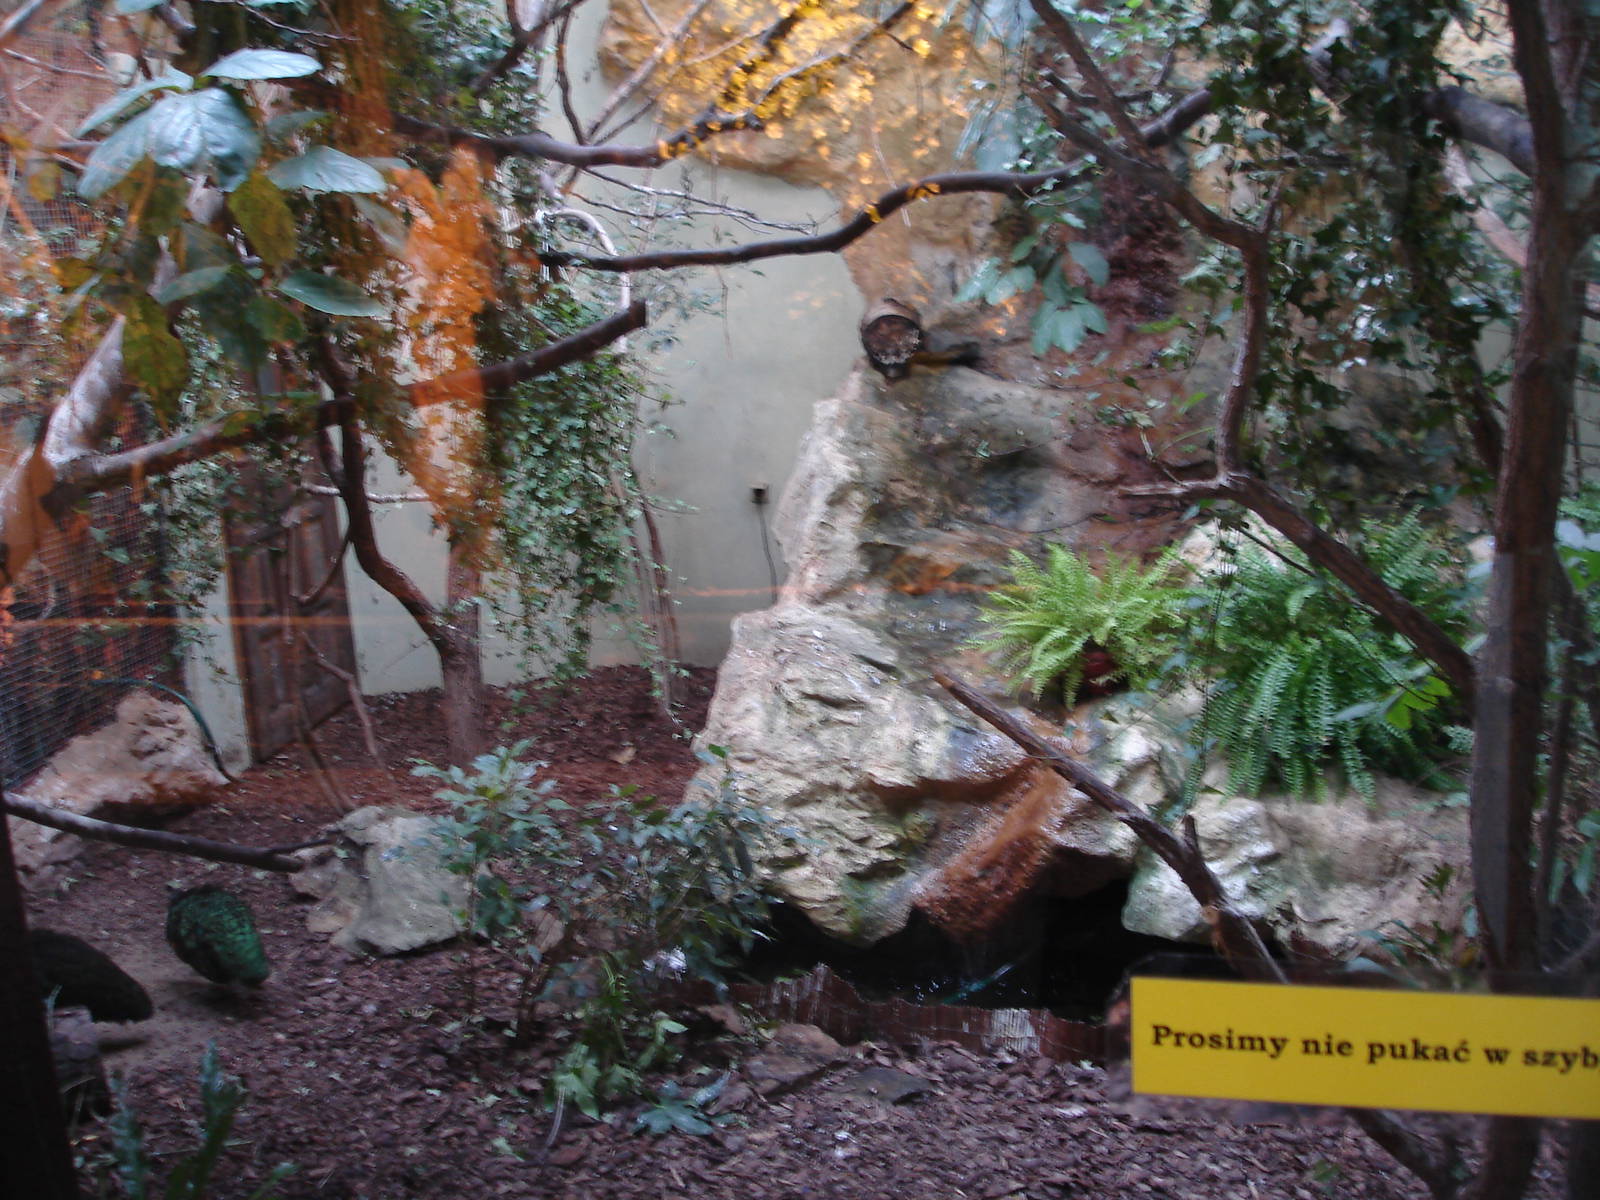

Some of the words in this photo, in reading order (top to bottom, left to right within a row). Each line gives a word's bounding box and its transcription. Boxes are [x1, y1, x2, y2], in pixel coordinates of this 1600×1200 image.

[1152, 1024, 1289, 1059] Prosimy
[1301, 1033, 1354, 1057] nie
[1367, 1037, 1472, 1065] pukać
[1483, 1047, 1511, 1065] w
[1523, 1045, 1600, 1074] szyb
